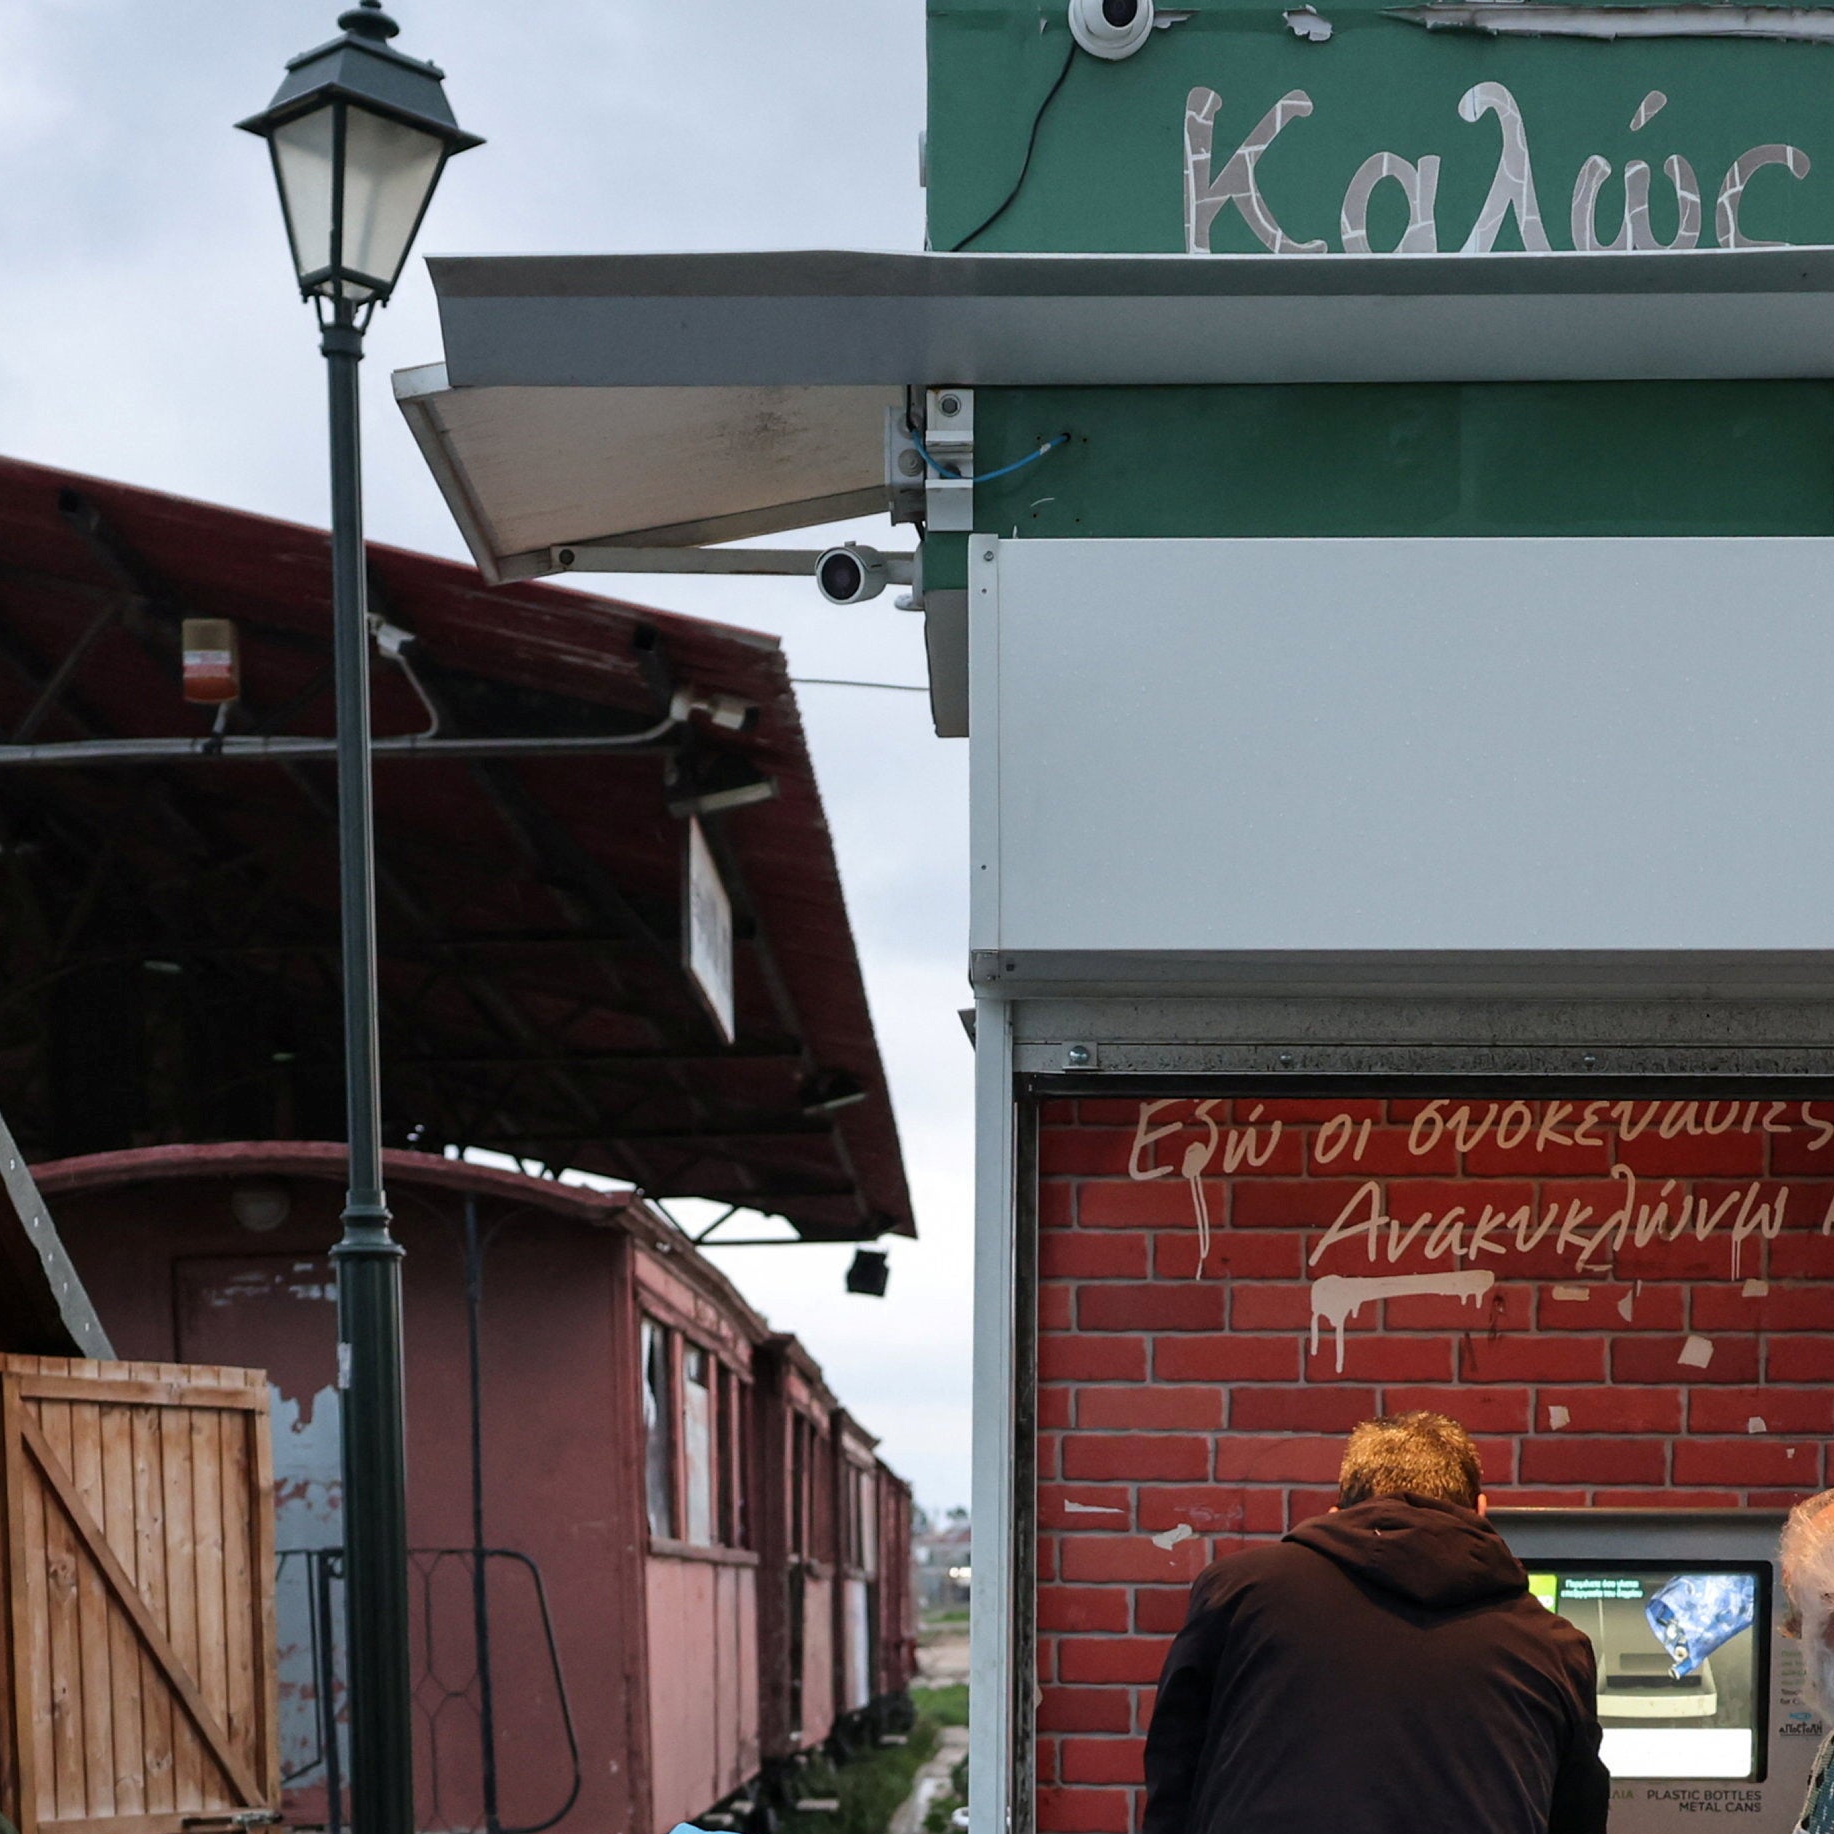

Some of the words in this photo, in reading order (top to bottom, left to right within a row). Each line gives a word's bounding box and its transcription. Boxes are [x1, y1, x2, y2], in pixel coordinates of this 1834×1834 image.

[1315, 1114, 1371, 1163] οι
[1647, 1790, 1699, 1800] PLASTIC
[1704, 1791, 1761, 1800] BOTTLES
[1679, 1802, 1720, 1812] METAL
[1725, 1802, 1761, 1812] CANS
